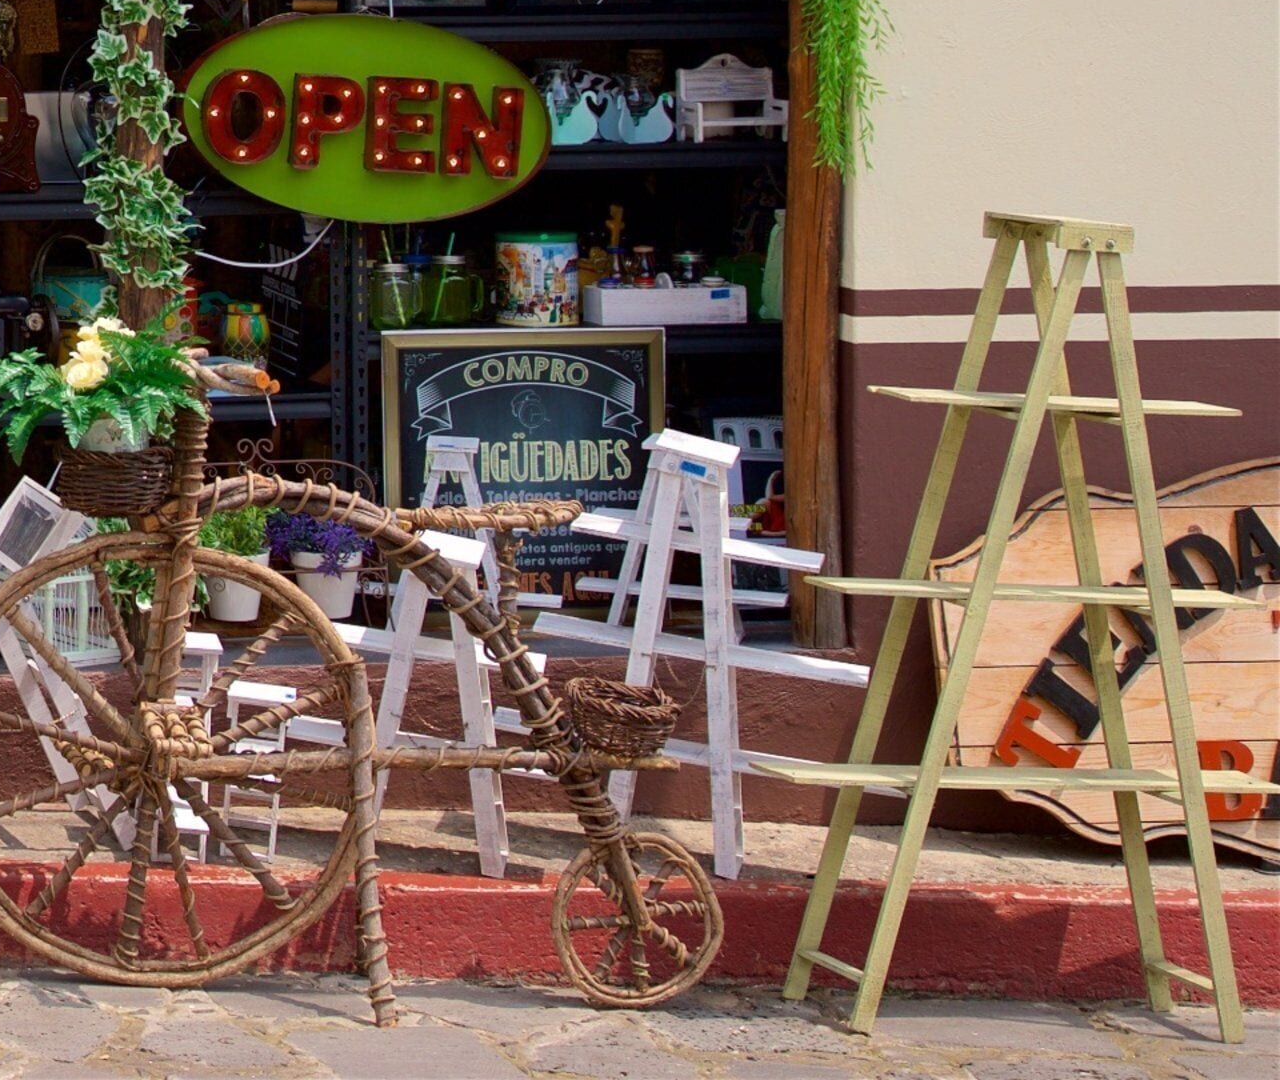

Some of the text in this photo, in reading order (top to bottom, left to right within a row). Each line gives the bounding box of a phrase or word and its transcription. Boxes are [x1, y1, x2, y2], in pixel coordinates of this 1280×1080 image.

[202, 69, 524, 179] OPEN
[463, 356, 589, 388] COMPRO
[549, 555, 592, 566] vender
[550, 542, 602, 556] antiguos
